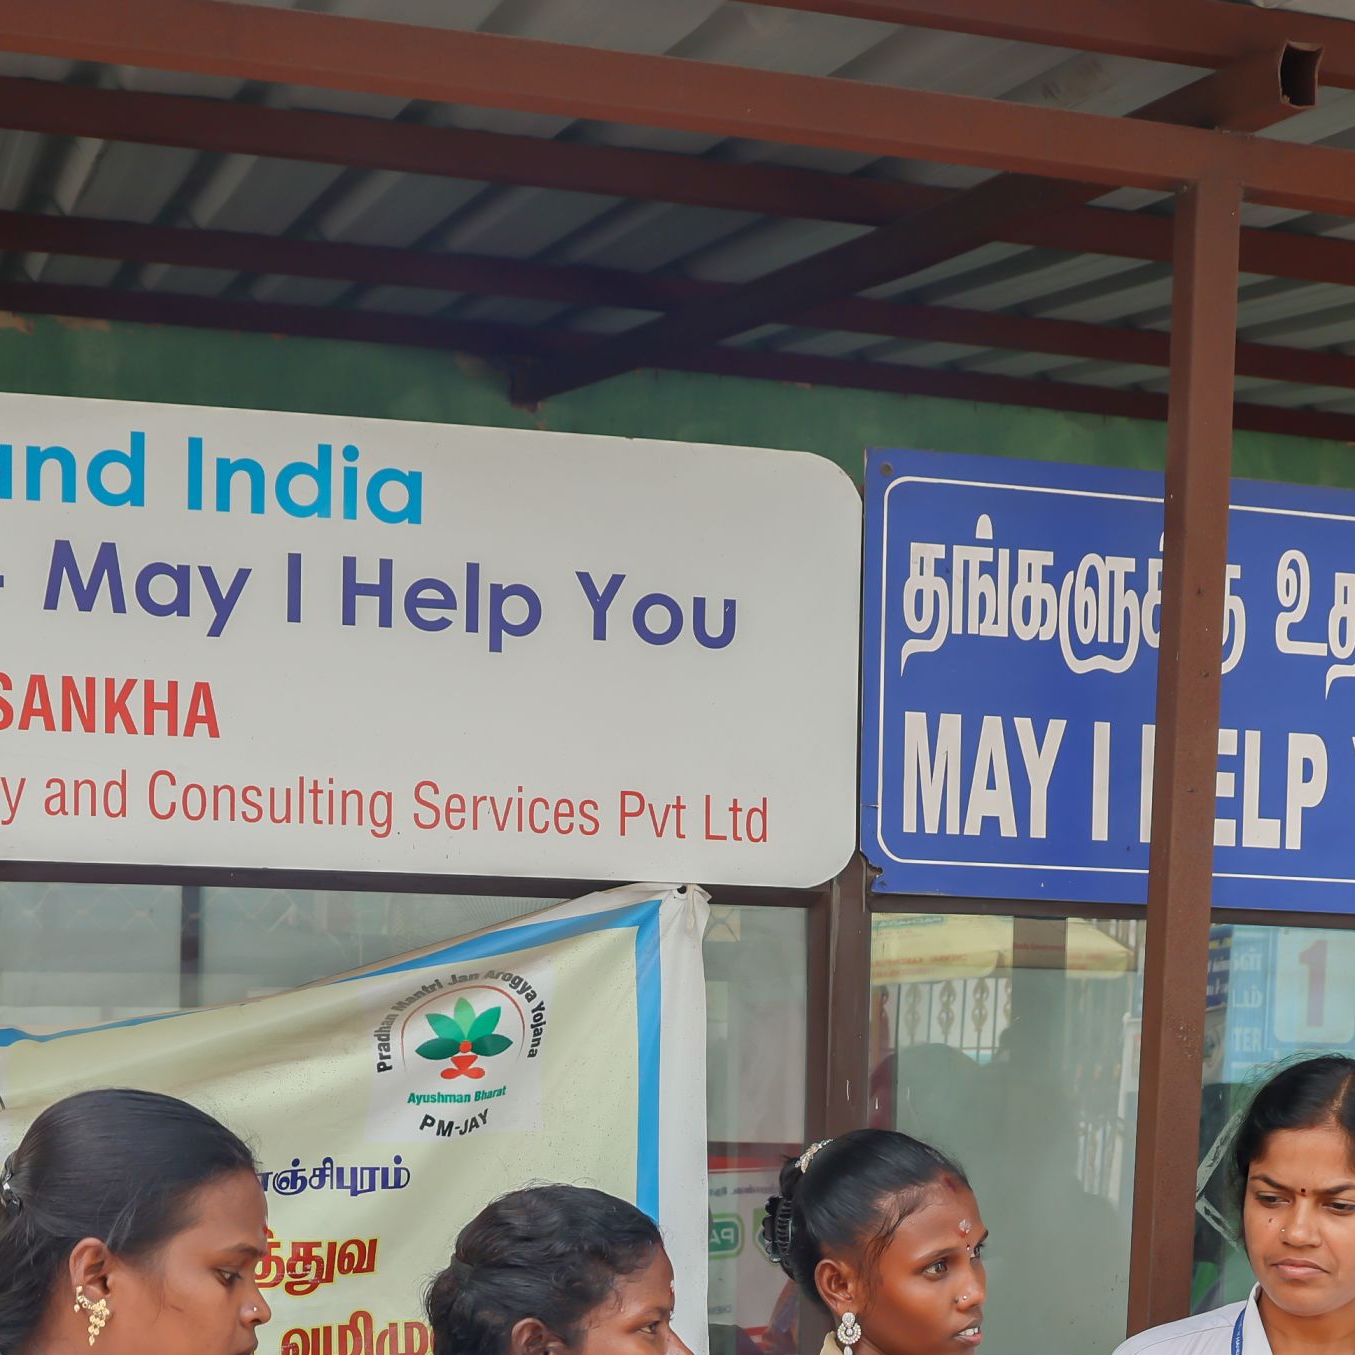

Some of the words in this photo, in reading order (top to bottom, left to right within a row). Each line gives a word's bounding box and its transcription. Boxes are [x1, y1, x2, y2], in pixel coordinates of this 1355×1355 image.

[188, 437, 423, 525] India
[43, 539, 252, 637] May
[287, 553, 301, 623] I
[342, 556, 543, 653] Help
[575, 571, 738, 649] You
[42, 768, 128, 820] and
[147, 769, 394, 837] Consulting
[412, 780, 601, 837] Services
[618, 790, 687, 840] Pvt
[703, 794, 769, 844] Ltd
[903, 711, 1066, 839] MAY
[1092, 722, 1110, 842] I
[1140, 724, 1328, 851] ELP
[374, 1013, 398, 1073] Pradhan
[394, 979, 444, 1012] Mantri
[448, 972, 478, 986] Jan
[484, 969, 537, 1003] Arogya
[527, 1000, 546, 1058] Yojana
[407, 1092, 471, 1106] Ayushman
[474, 1085, 507, 1102] Bharat
[419, 1108, 489, 1137] PM-JAY
